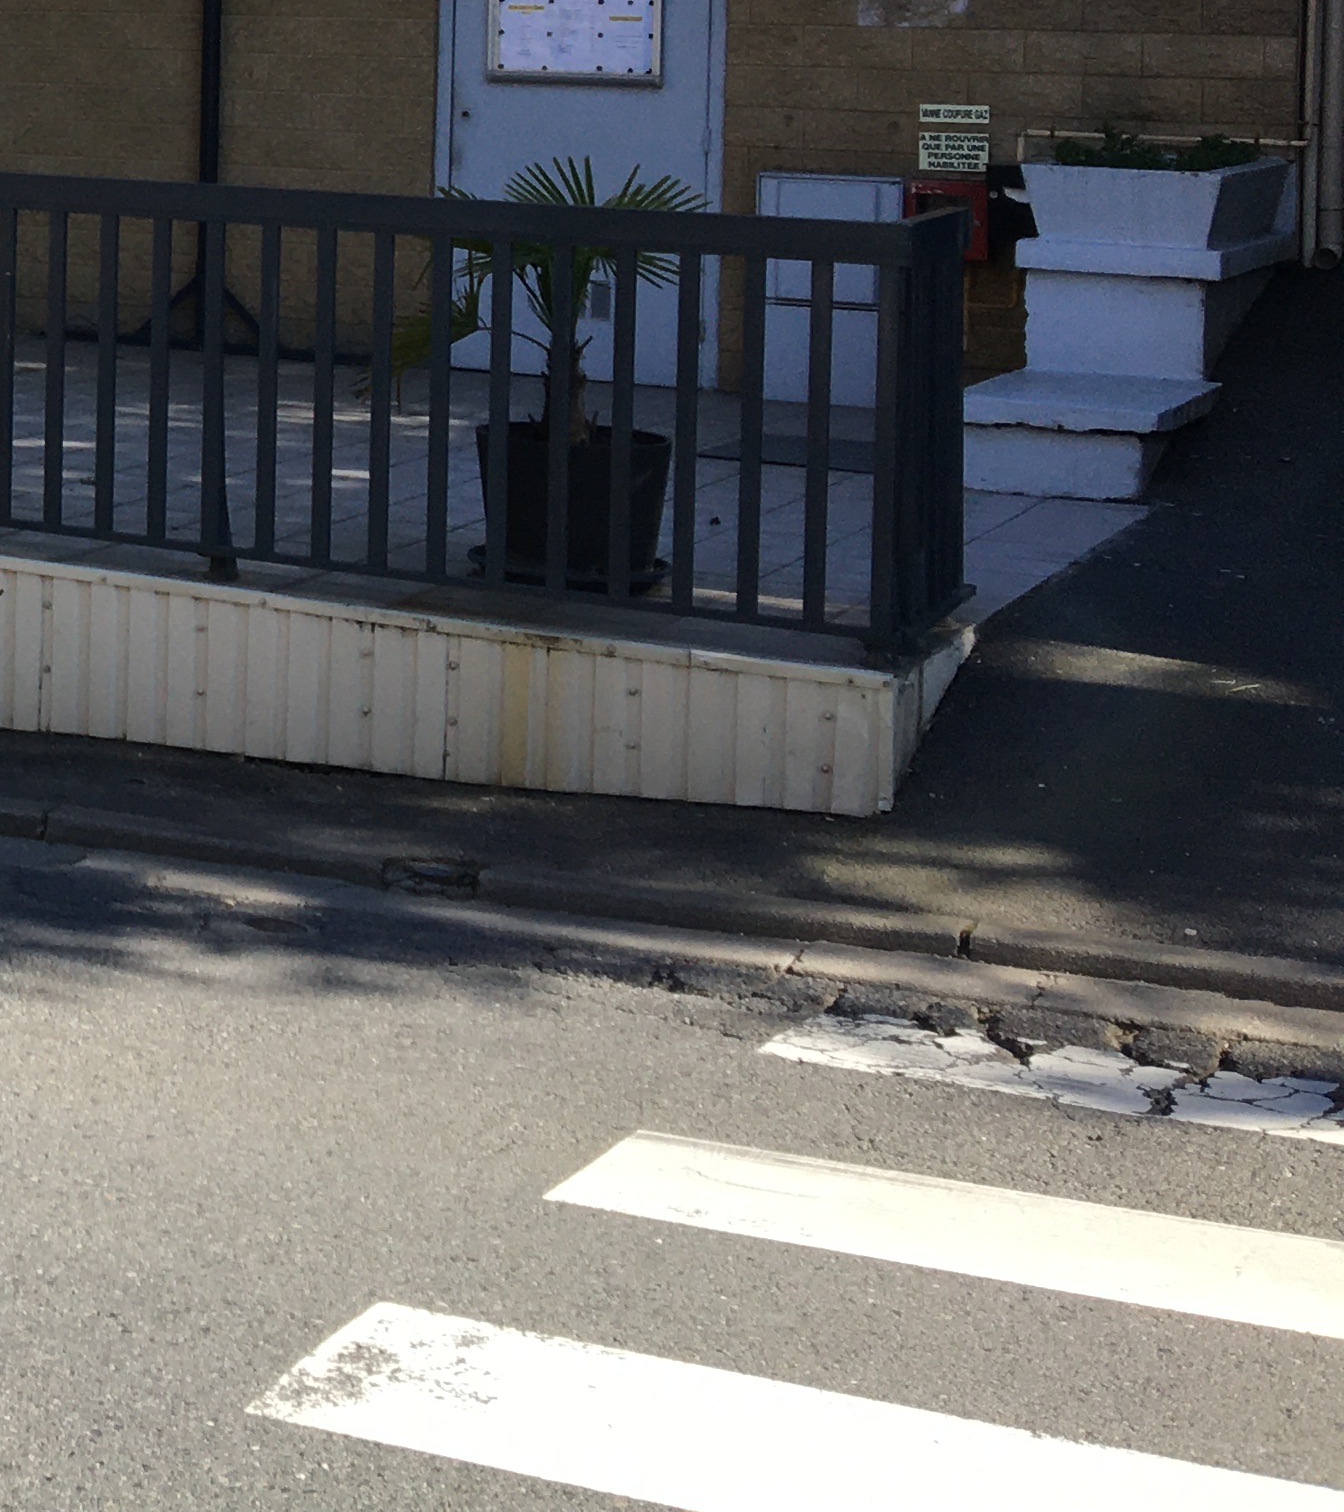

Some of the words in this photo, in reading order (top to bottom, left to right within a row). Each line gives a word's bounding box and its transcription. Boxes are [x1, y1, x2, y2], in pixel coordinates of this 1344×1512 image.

[929, 134, 943, 142] NE
[922, 143, 942, 151] QUE
[945, 144, 964, 152] PAR
[967, 144, 987, 152] UNE
[928, 152, 981, 161] PERSONNE
